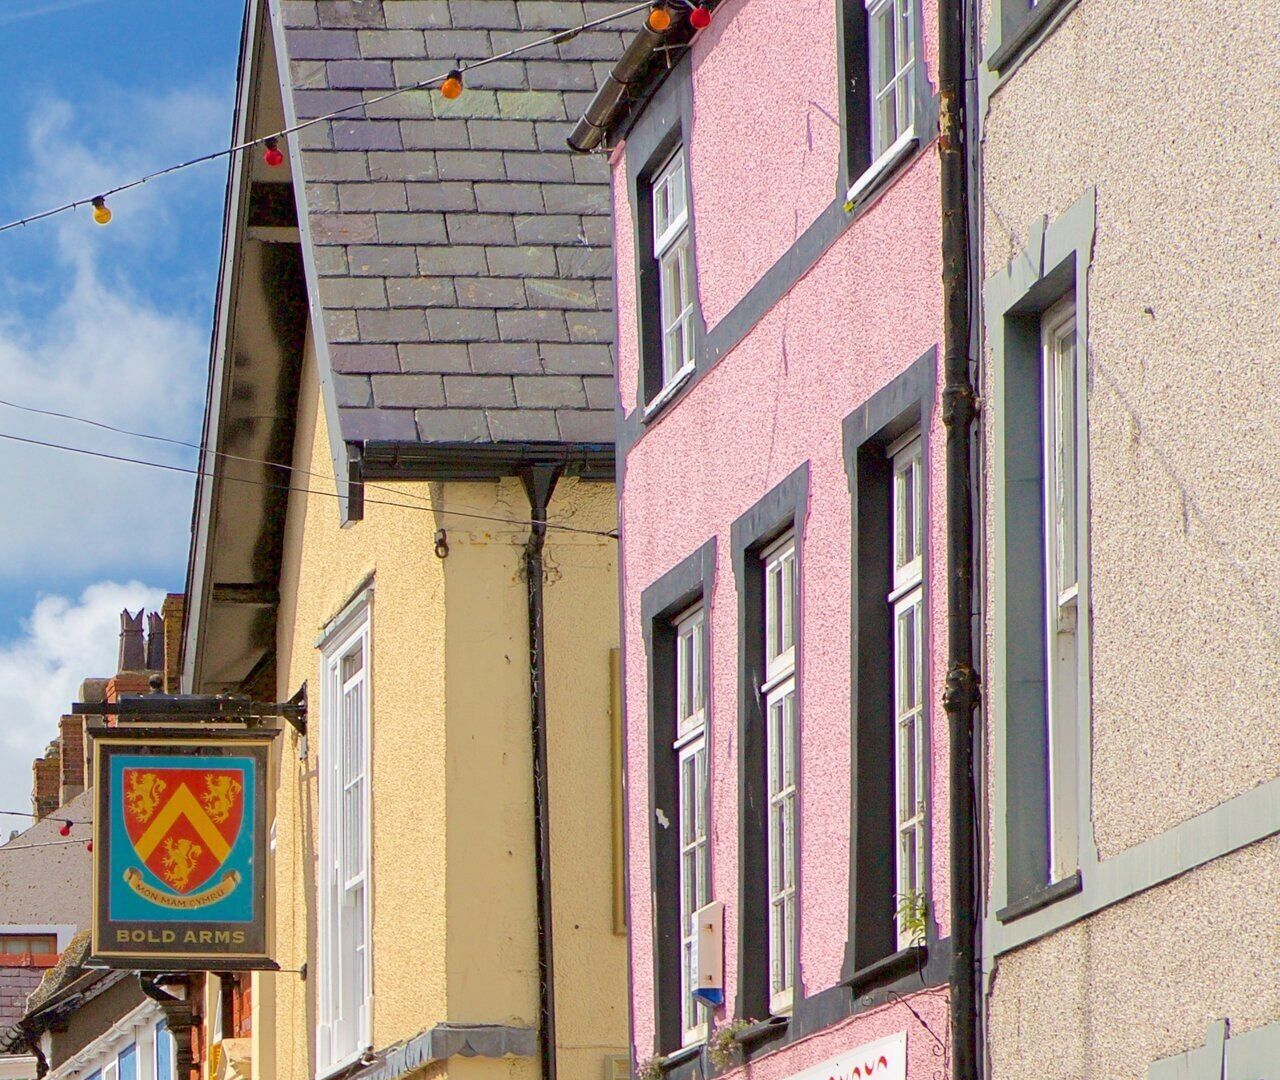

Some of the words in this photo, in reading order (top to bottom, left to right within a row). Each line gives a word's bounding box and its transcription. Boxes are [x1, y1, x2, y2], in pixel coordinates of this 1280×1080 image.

[160, 897, 186, 907] MAM
[190, 889, 225, 906] CYMRU
[116, 929, 176, 943] BOLD
[183, 930, 245, 944] ARMS
